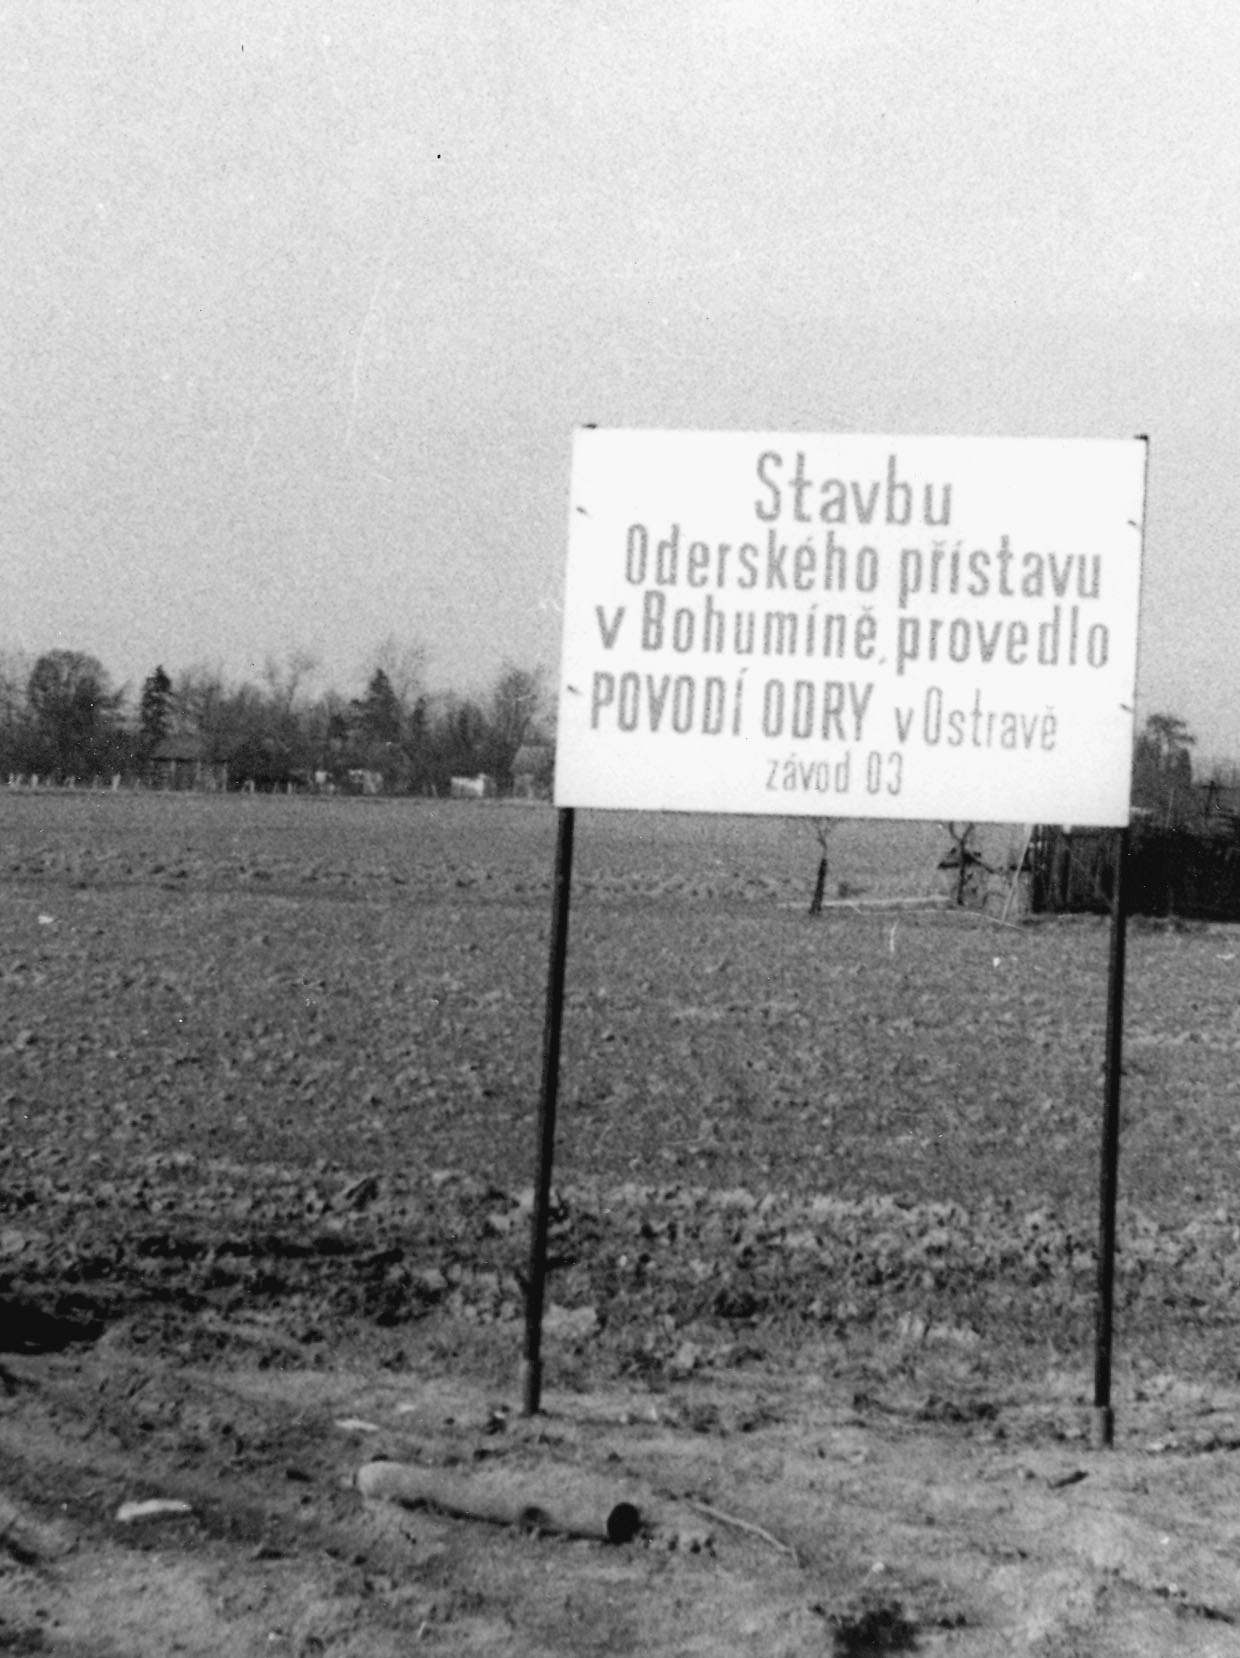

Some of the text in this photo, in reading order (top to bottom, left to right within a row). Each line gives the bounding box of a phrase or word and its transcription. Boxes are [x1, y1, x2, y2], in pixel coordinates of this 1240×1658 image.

[754, 450, 953, 528] Stavbu
[624, 523, 1102, 609] Oderského přístavu
[594, 589, 1110, 676] v Bohumíně, provedlo
[589, 666, 1058, 752] POVODÍ ODRY v Ostravě
[765, 750, 904, 798] závod 03
